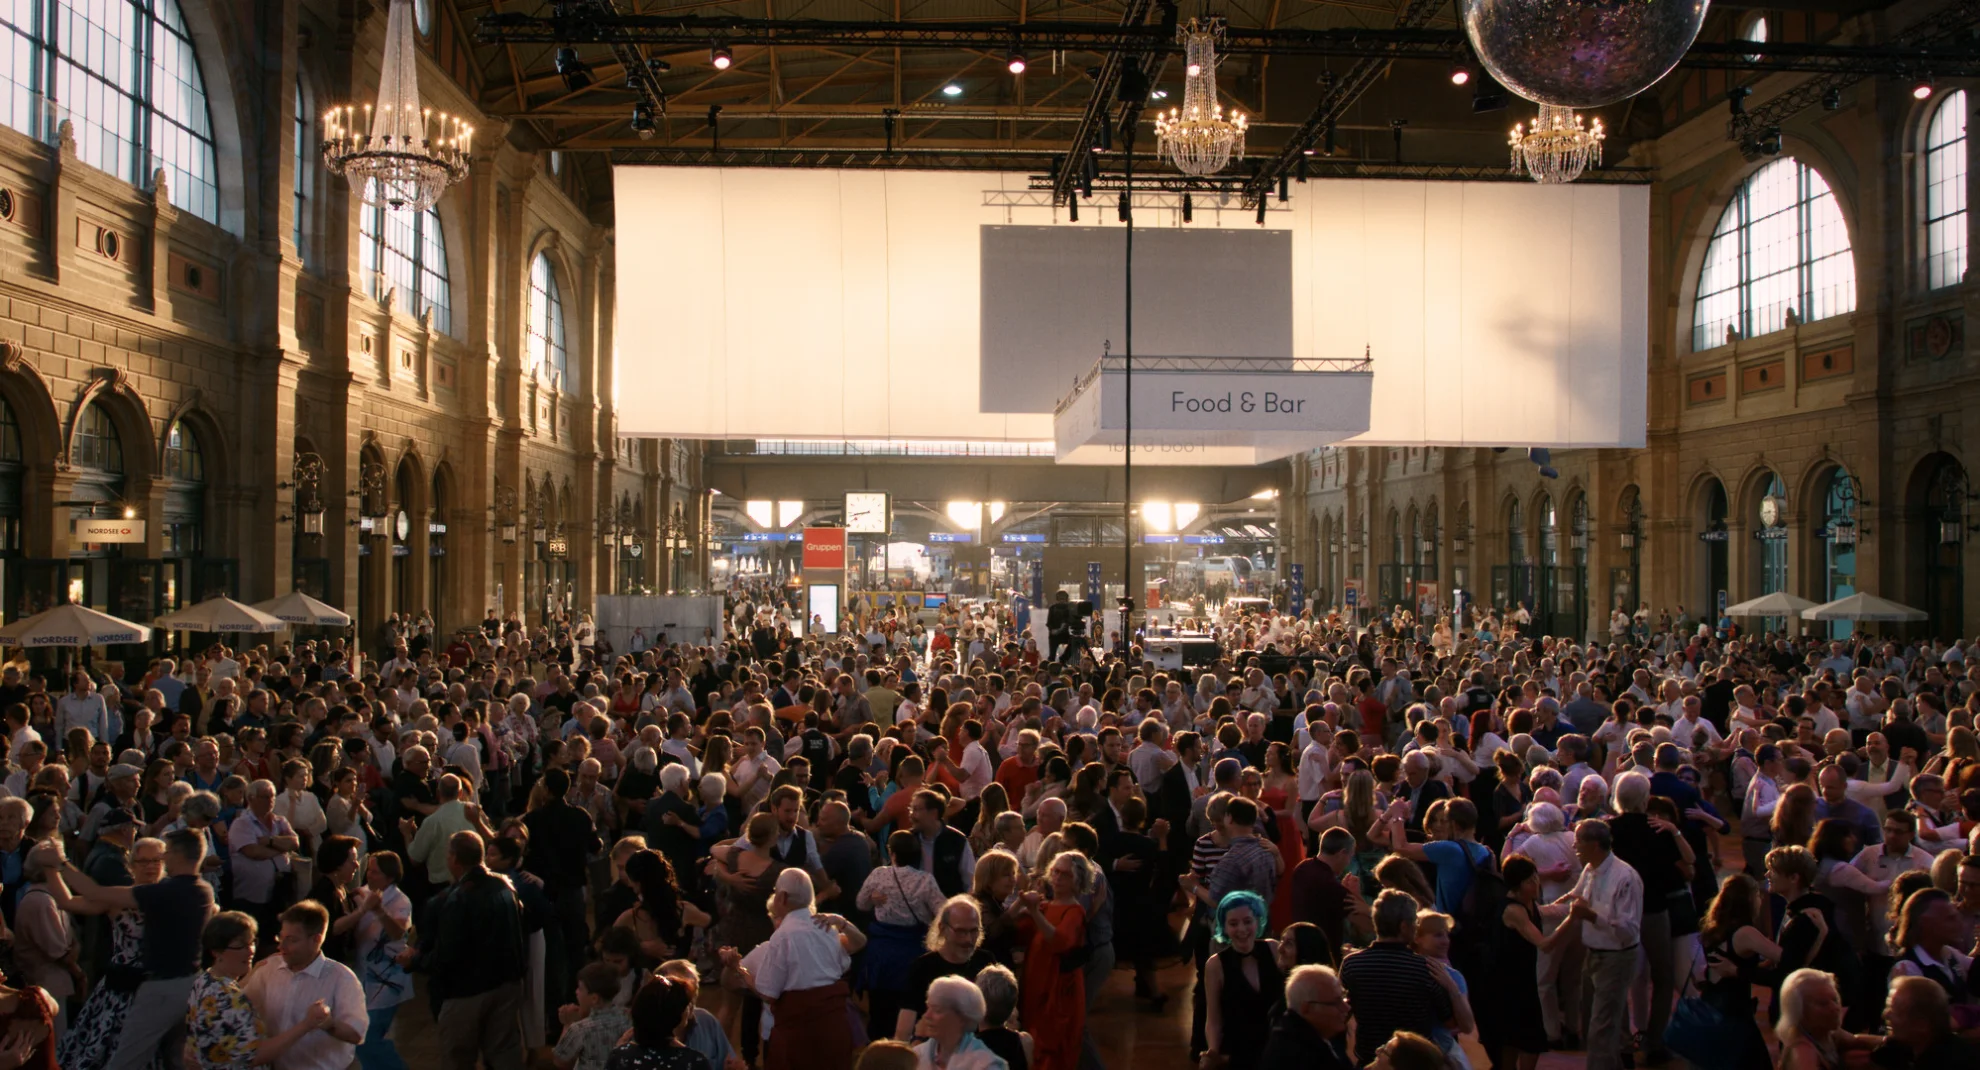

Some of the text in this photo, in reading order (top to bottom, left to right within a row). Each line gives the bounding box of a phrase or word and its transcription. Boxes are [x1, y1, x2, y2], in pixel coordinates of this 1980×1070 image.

[1172, 391, 1306, 414] Food & Bar
[806, 543, 842, 552] Gruppen
[32, 636, 79, 644] NORDSEE
[96, 633, 133, 643] NORDSEE
